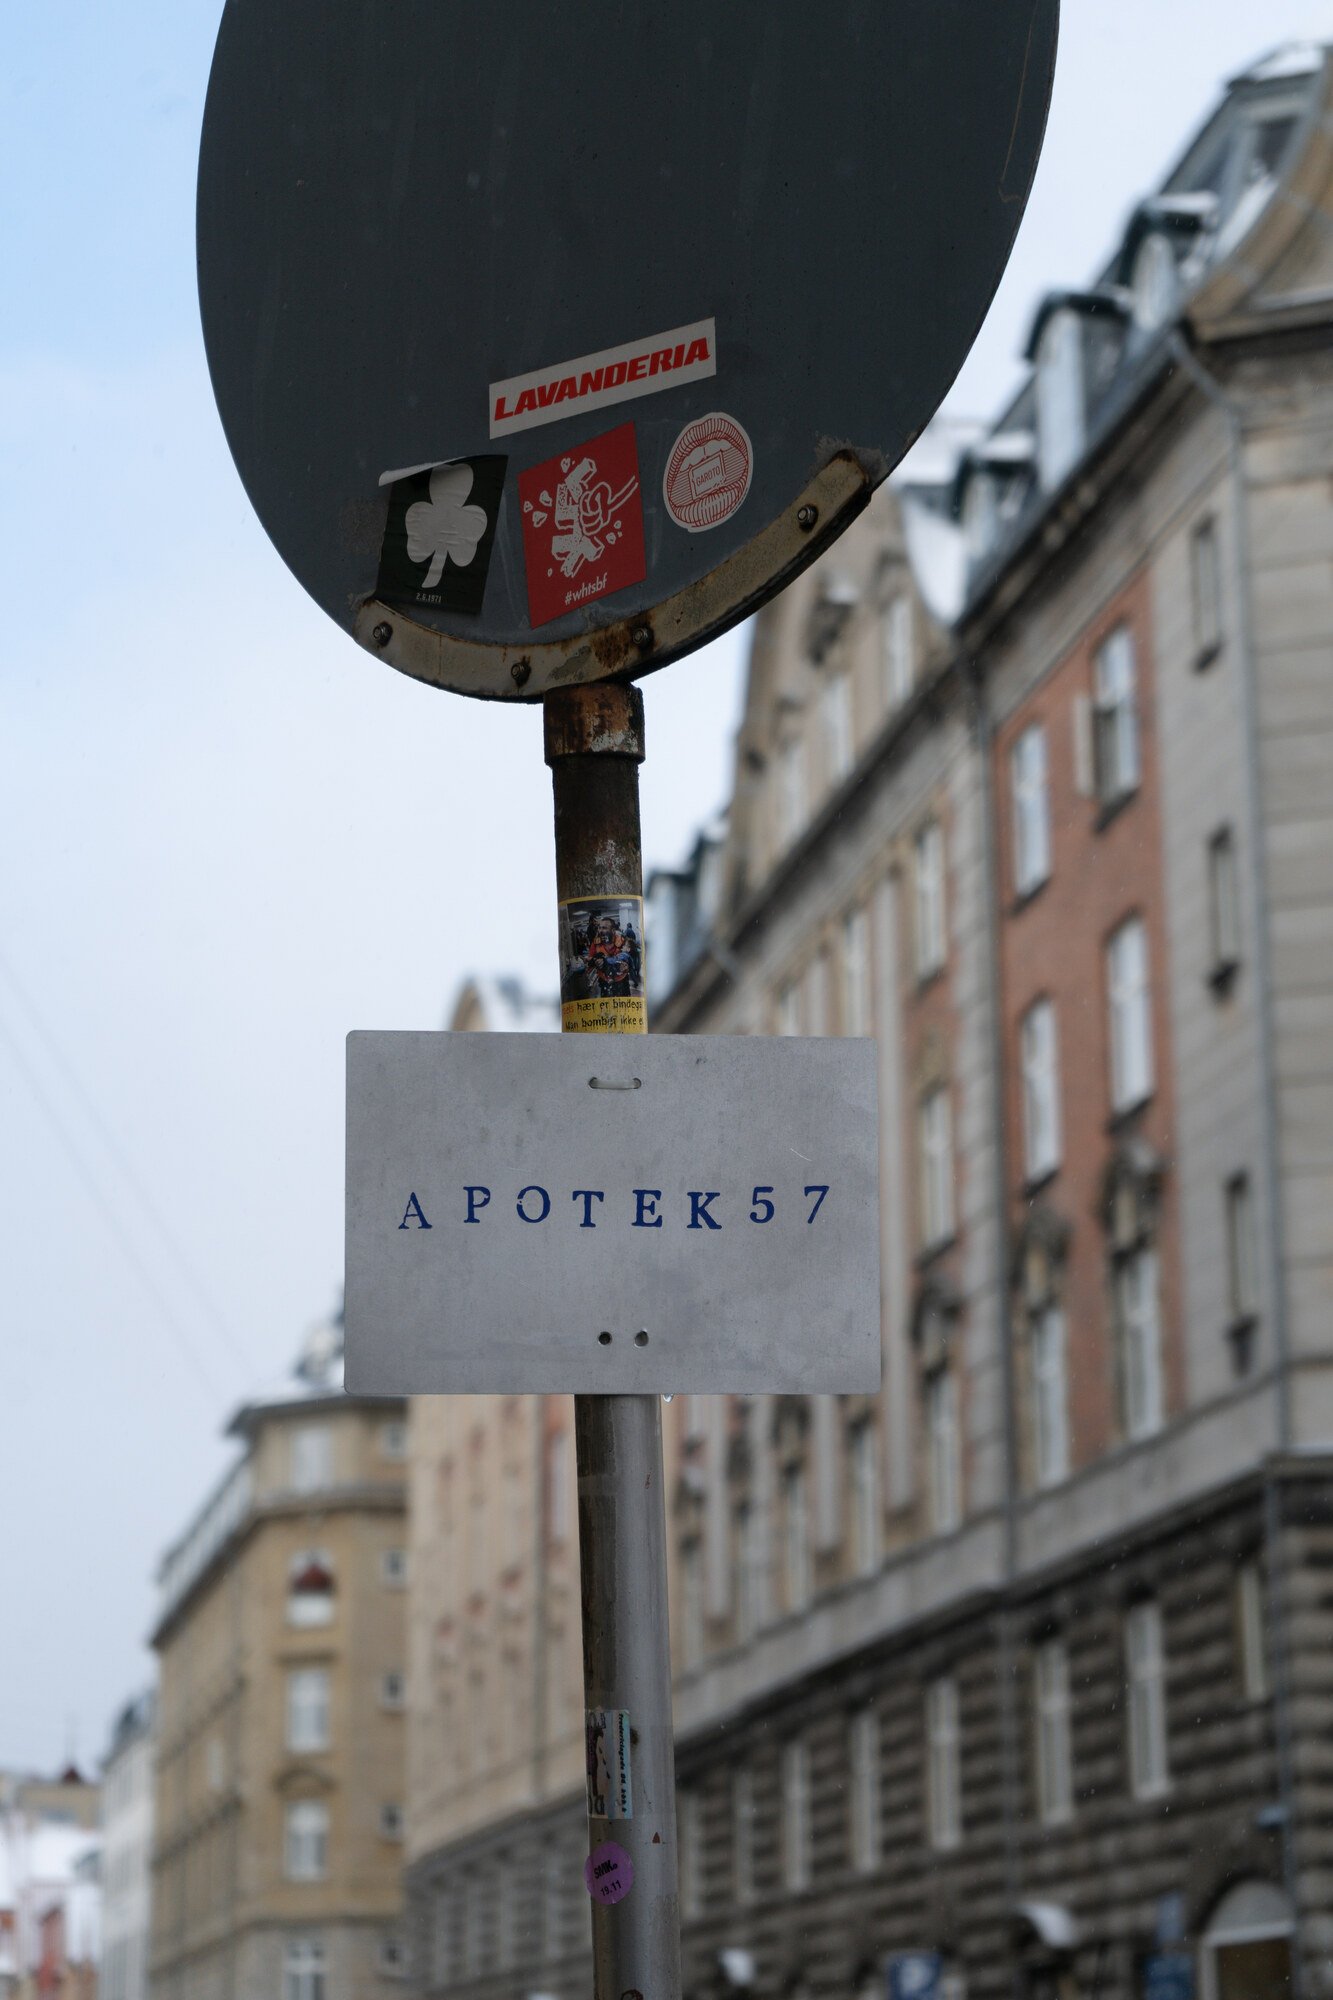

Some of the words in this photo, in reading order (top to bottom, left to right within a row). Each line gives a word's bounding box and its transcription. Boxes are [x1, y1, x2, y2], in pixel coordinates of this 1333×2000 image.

[494, 336, 711, 421] LAVANDERIA
[565, 572, 607, 606] #whtsbf
[600, 1001, 609, 1010] er
[620, 1014, 636, 1025] ikke
[601, 1880, 621, 1897] 19.11
